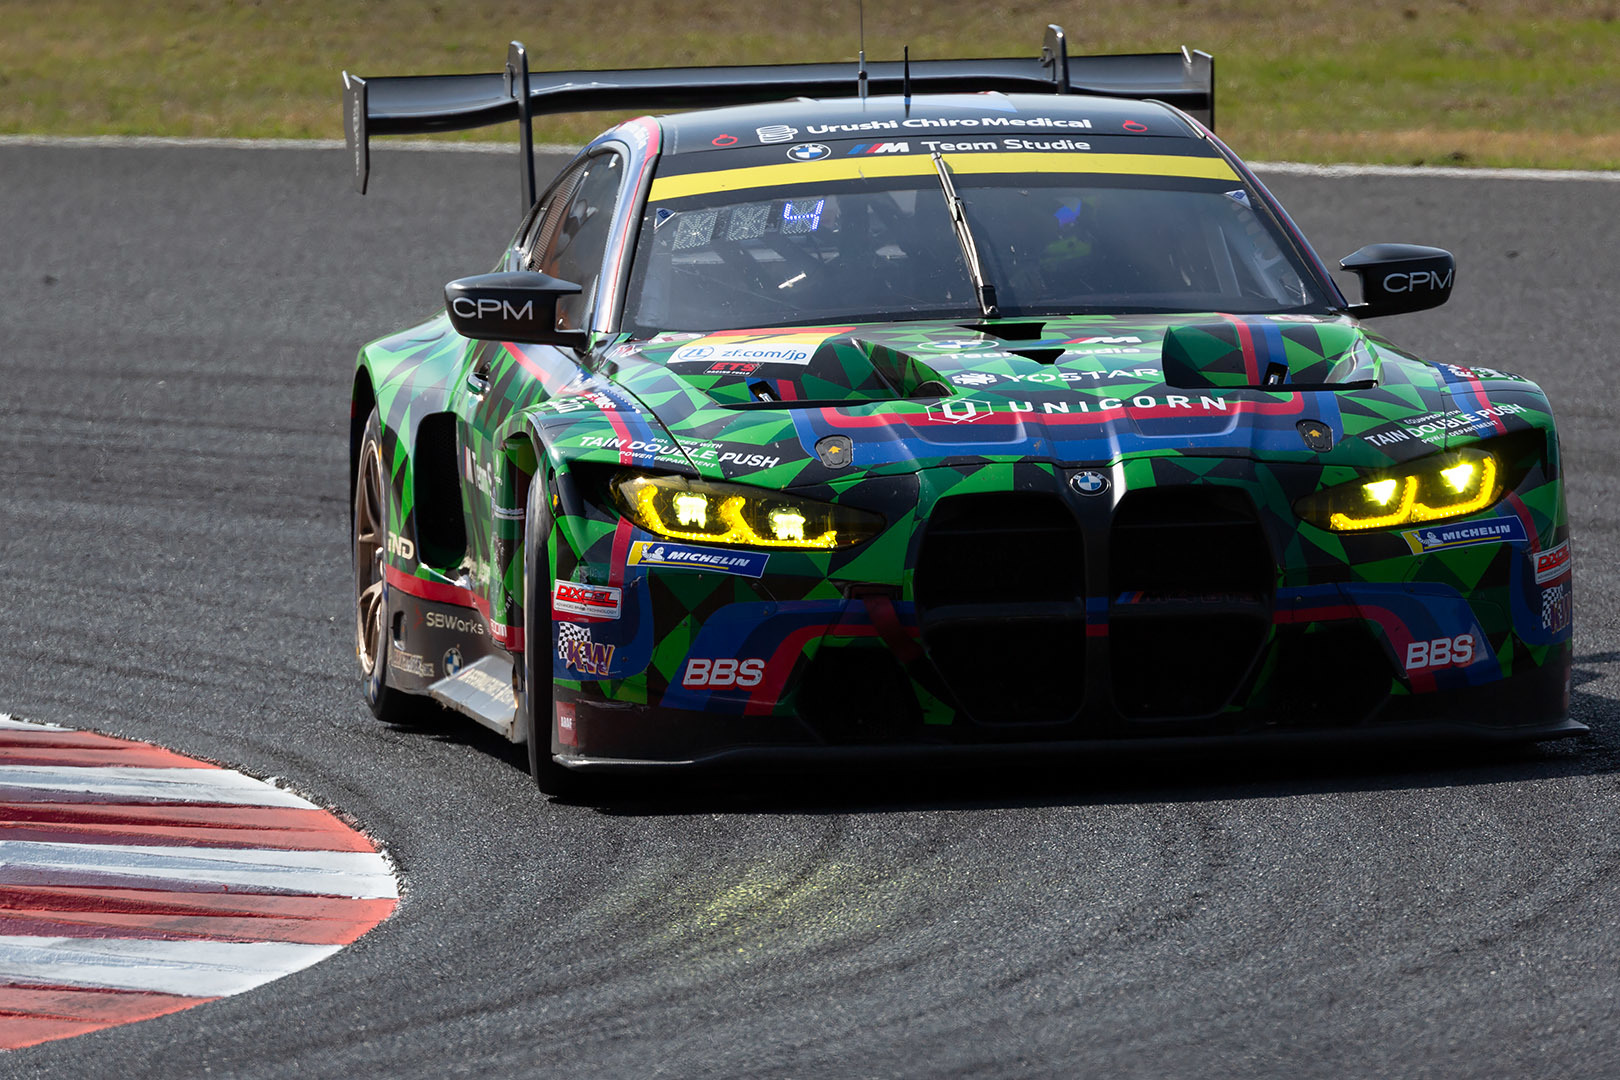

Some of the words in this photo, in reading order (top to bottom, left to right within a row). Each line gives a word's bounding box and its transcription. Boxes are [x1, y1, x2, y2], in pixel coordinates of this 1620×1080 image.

[806, 119, 899, 135] Urushi
[902, 118, 981, 129] Chiro
[982, 117, 1093, 129] Medical
[920, 140, 998, 152] Team
[1003, 138, 1092, 151] Studie
[783, 199, 825, 231] 4
[1382, 268, 1453, 293] CPM
[452, 296, 533, 321] CPM
[721, 349, 807, 361] zf.com/jp
[711, 362, 760, 372] ETS
[1001, 368, 1160, 383] YOSTAR
[1008, 395, 1227, 414] UNICORN
[1364, 429, 1410, 448] TAIN
[1406, 413, 1481, 438] DOUBLE
[1475, 403, 1528, 420] PUSH
[579, 436, 627, 449] TAIN
[627, 440, 719, 460] DOUBLE
[719, 452, 780, 468] PUSH
[618, 450, 653, 460] POWER
[1441, 524, 1511, 541] MICHELIN
[666, 551, 751, 567] MICHELIN
[426, 611, 485, 635] SBWorks
[567, 640, 616, 677] KW
[1406, 635, 1474, 670] BBS
[682, 658, 766, 687] BBS
